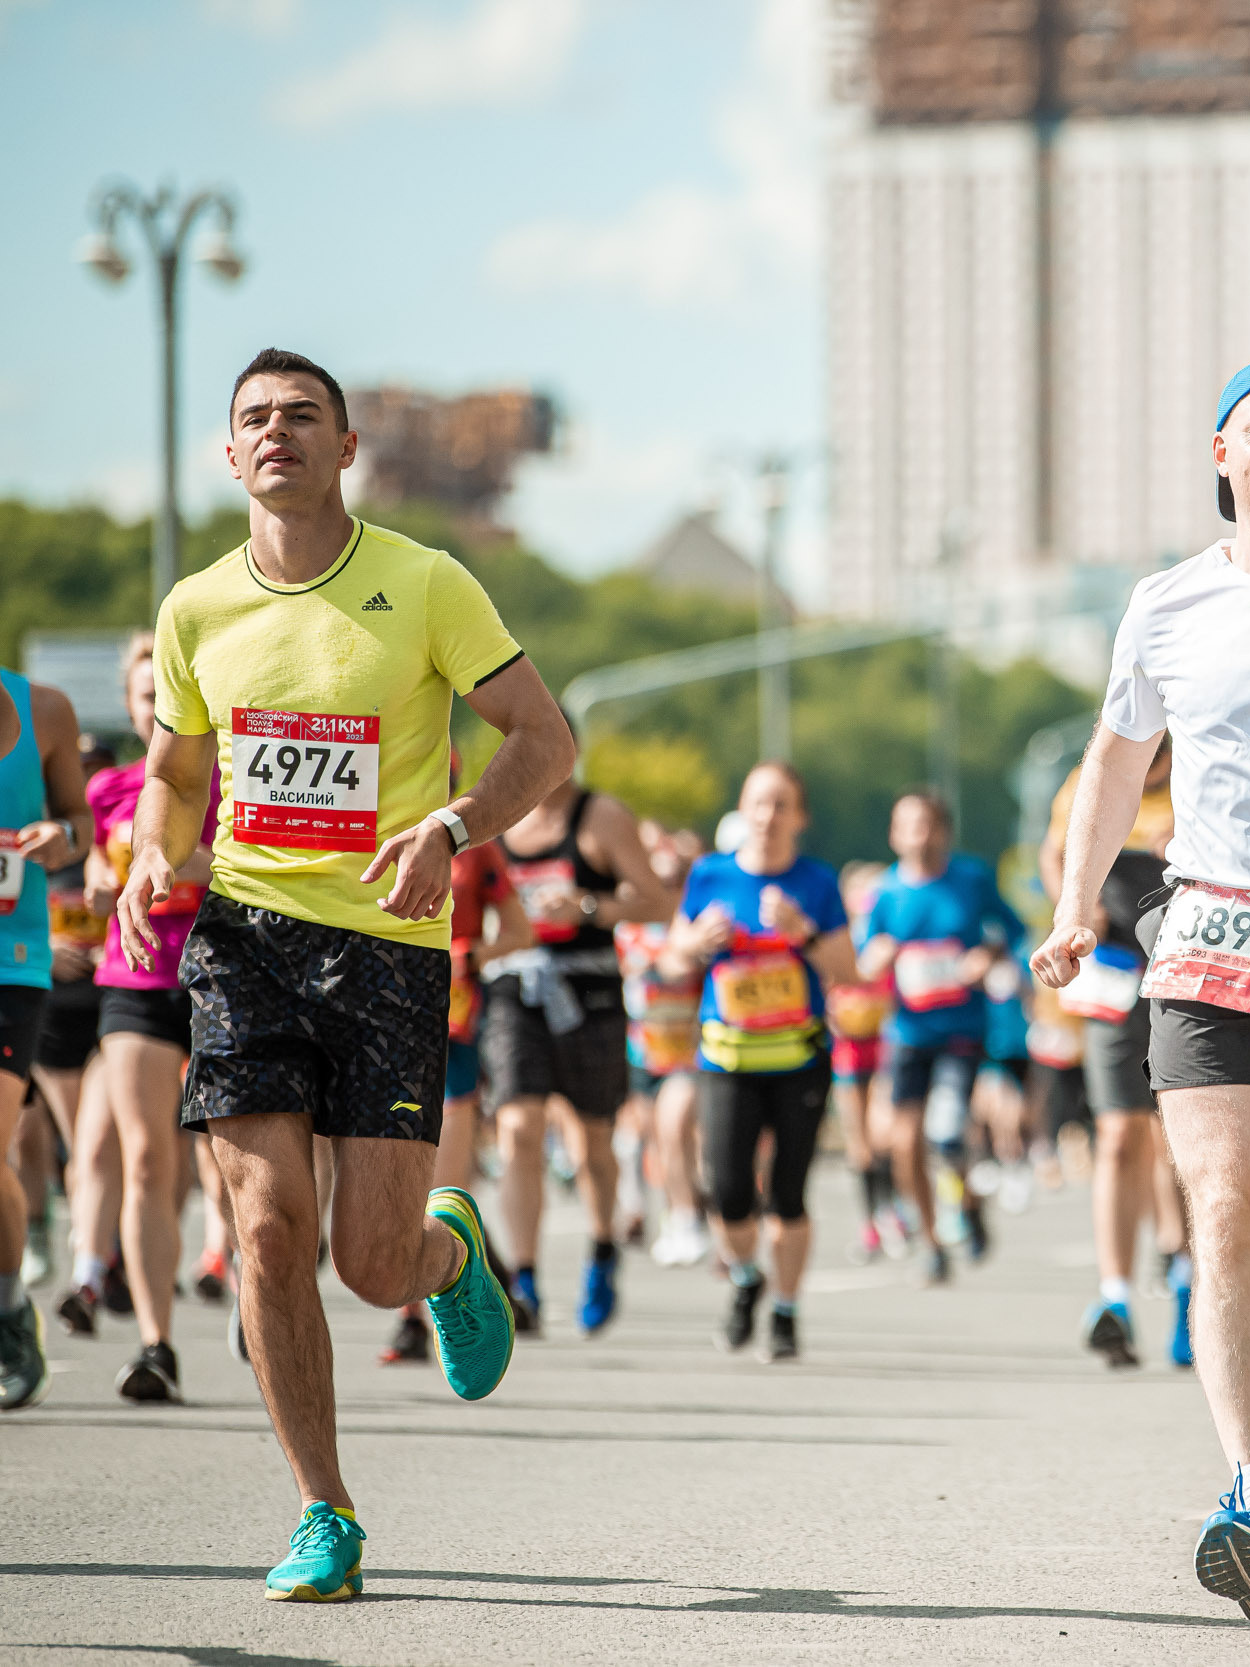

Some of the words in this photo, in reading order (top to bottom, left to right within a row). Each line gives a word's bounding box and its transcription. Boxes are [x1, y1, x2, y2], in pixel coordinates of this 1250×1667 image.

[361, 603, 393, 611] adidas
[246, 711, 299, 722] МОСКОВСКИЙ
[246, 719, 267, 727] ПОЛУ
[246, 726, 284, 735] МАРАФОН
[345, 733, 365, 741] 2023
[247, 743, 360, 791] 4974
[269, 790, 334, 806] ВАСИЛИЙ
